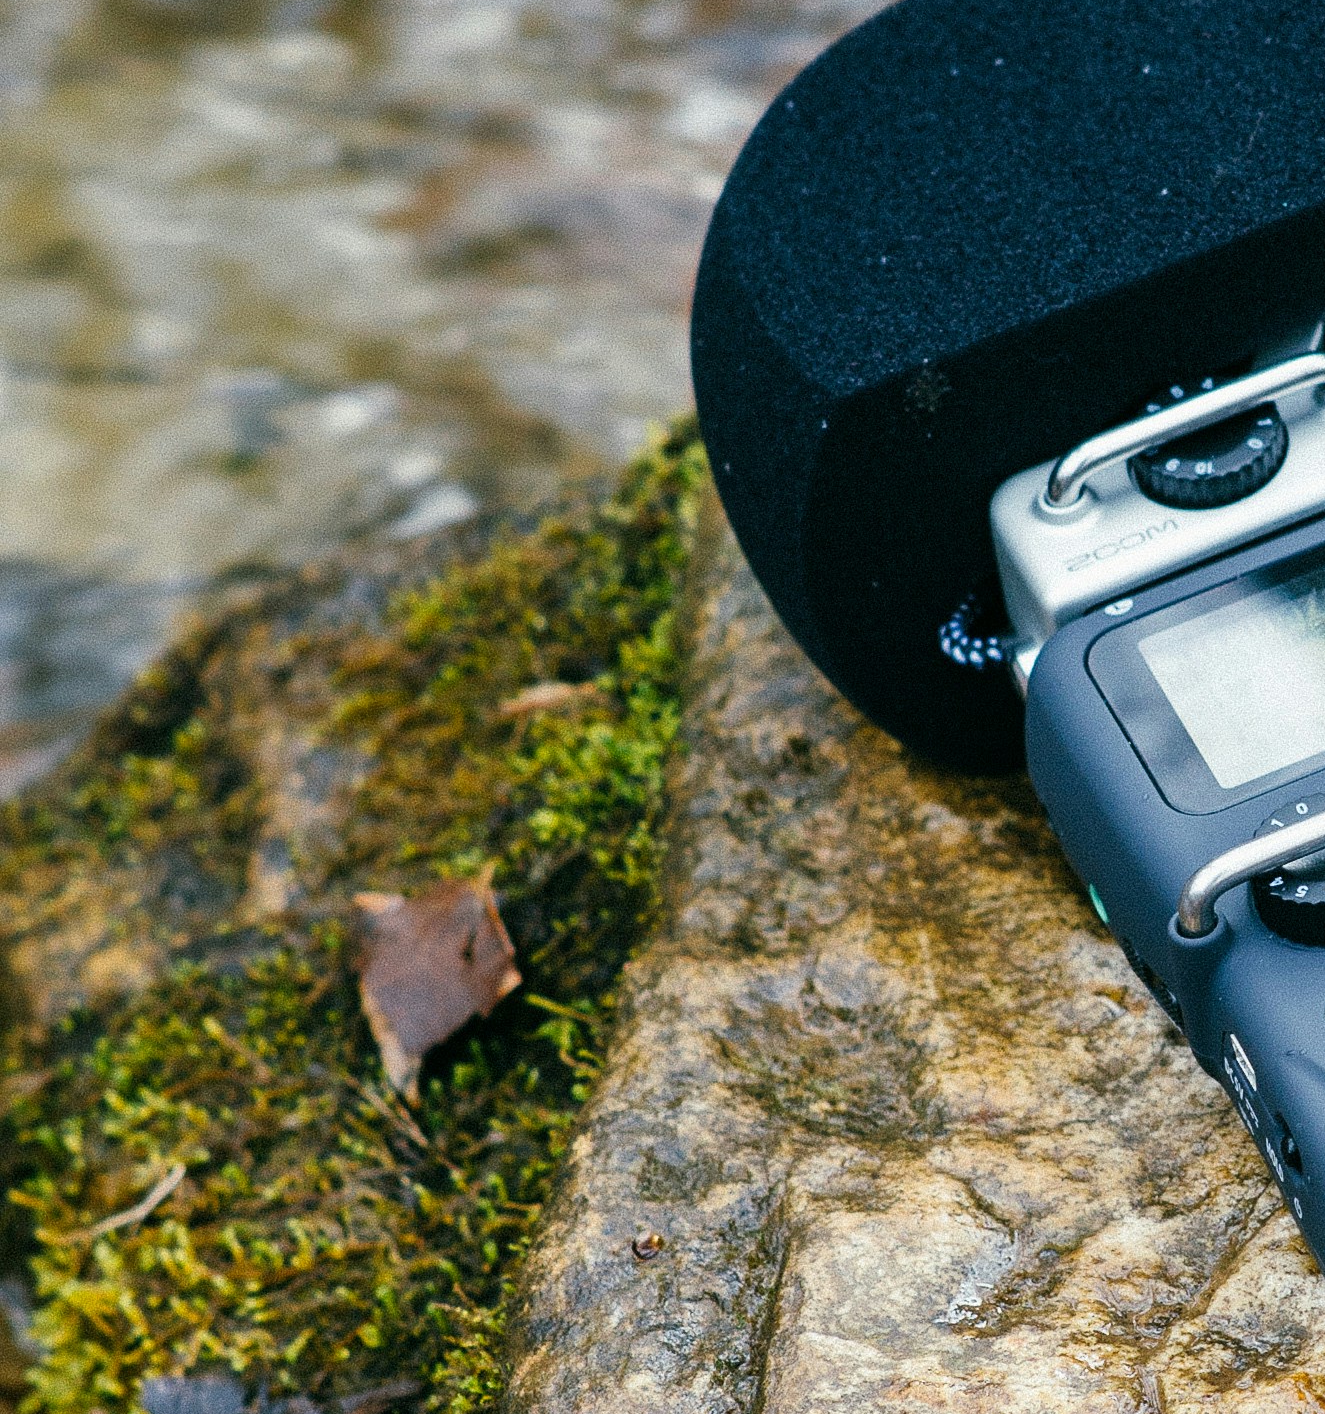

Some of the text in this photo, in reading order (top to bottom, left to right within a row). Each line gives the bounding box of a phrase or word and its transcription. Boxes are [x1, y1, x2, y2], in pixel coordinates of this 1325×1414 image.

[1064, 518, 1180, 573] ZOOM
[1270, 802, 1309, 828] 1 0
[1269, 876, 1284, 887] 4
[1294, 884, 1309, 898] 5
